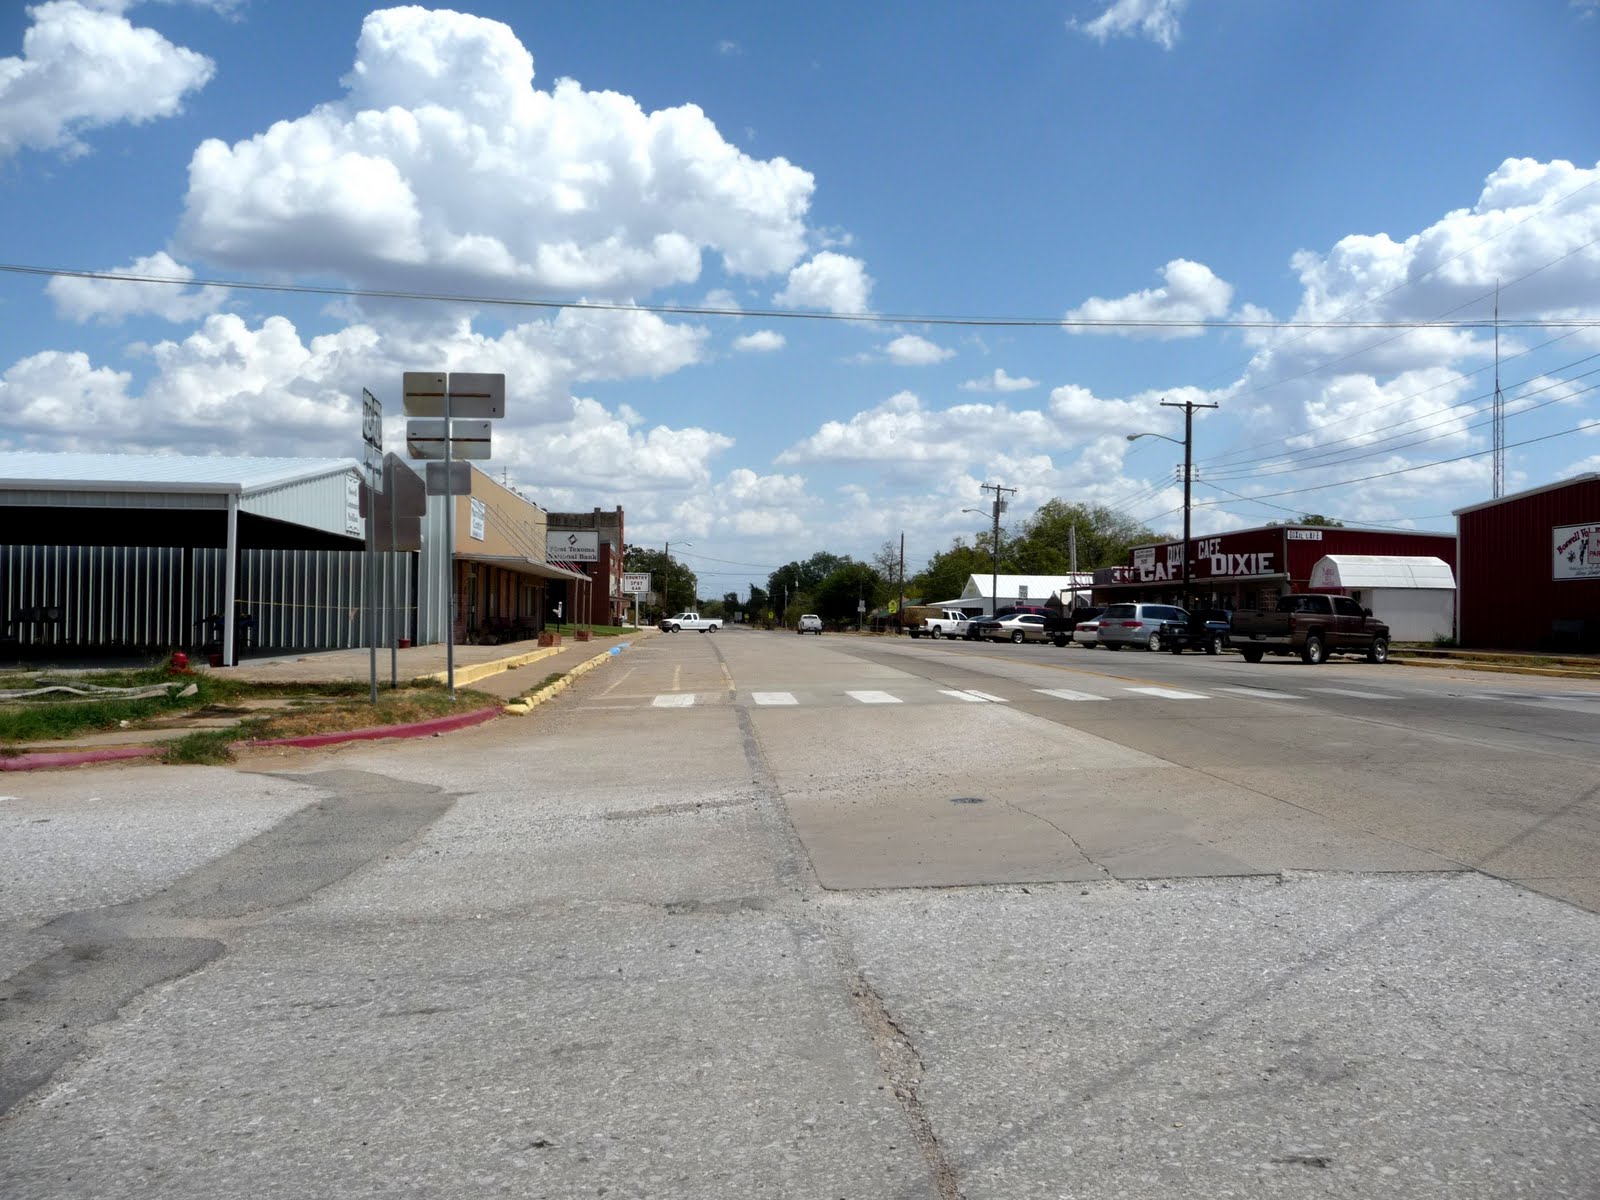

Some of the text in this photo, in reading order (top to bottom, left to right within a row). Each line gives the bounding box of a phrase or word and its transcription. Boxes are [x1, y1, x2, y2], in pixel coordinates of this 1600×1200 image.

[1167, 538, 1221, 563] DIXI CAFE
[1210, 552, 1275, 575] DIXIE
